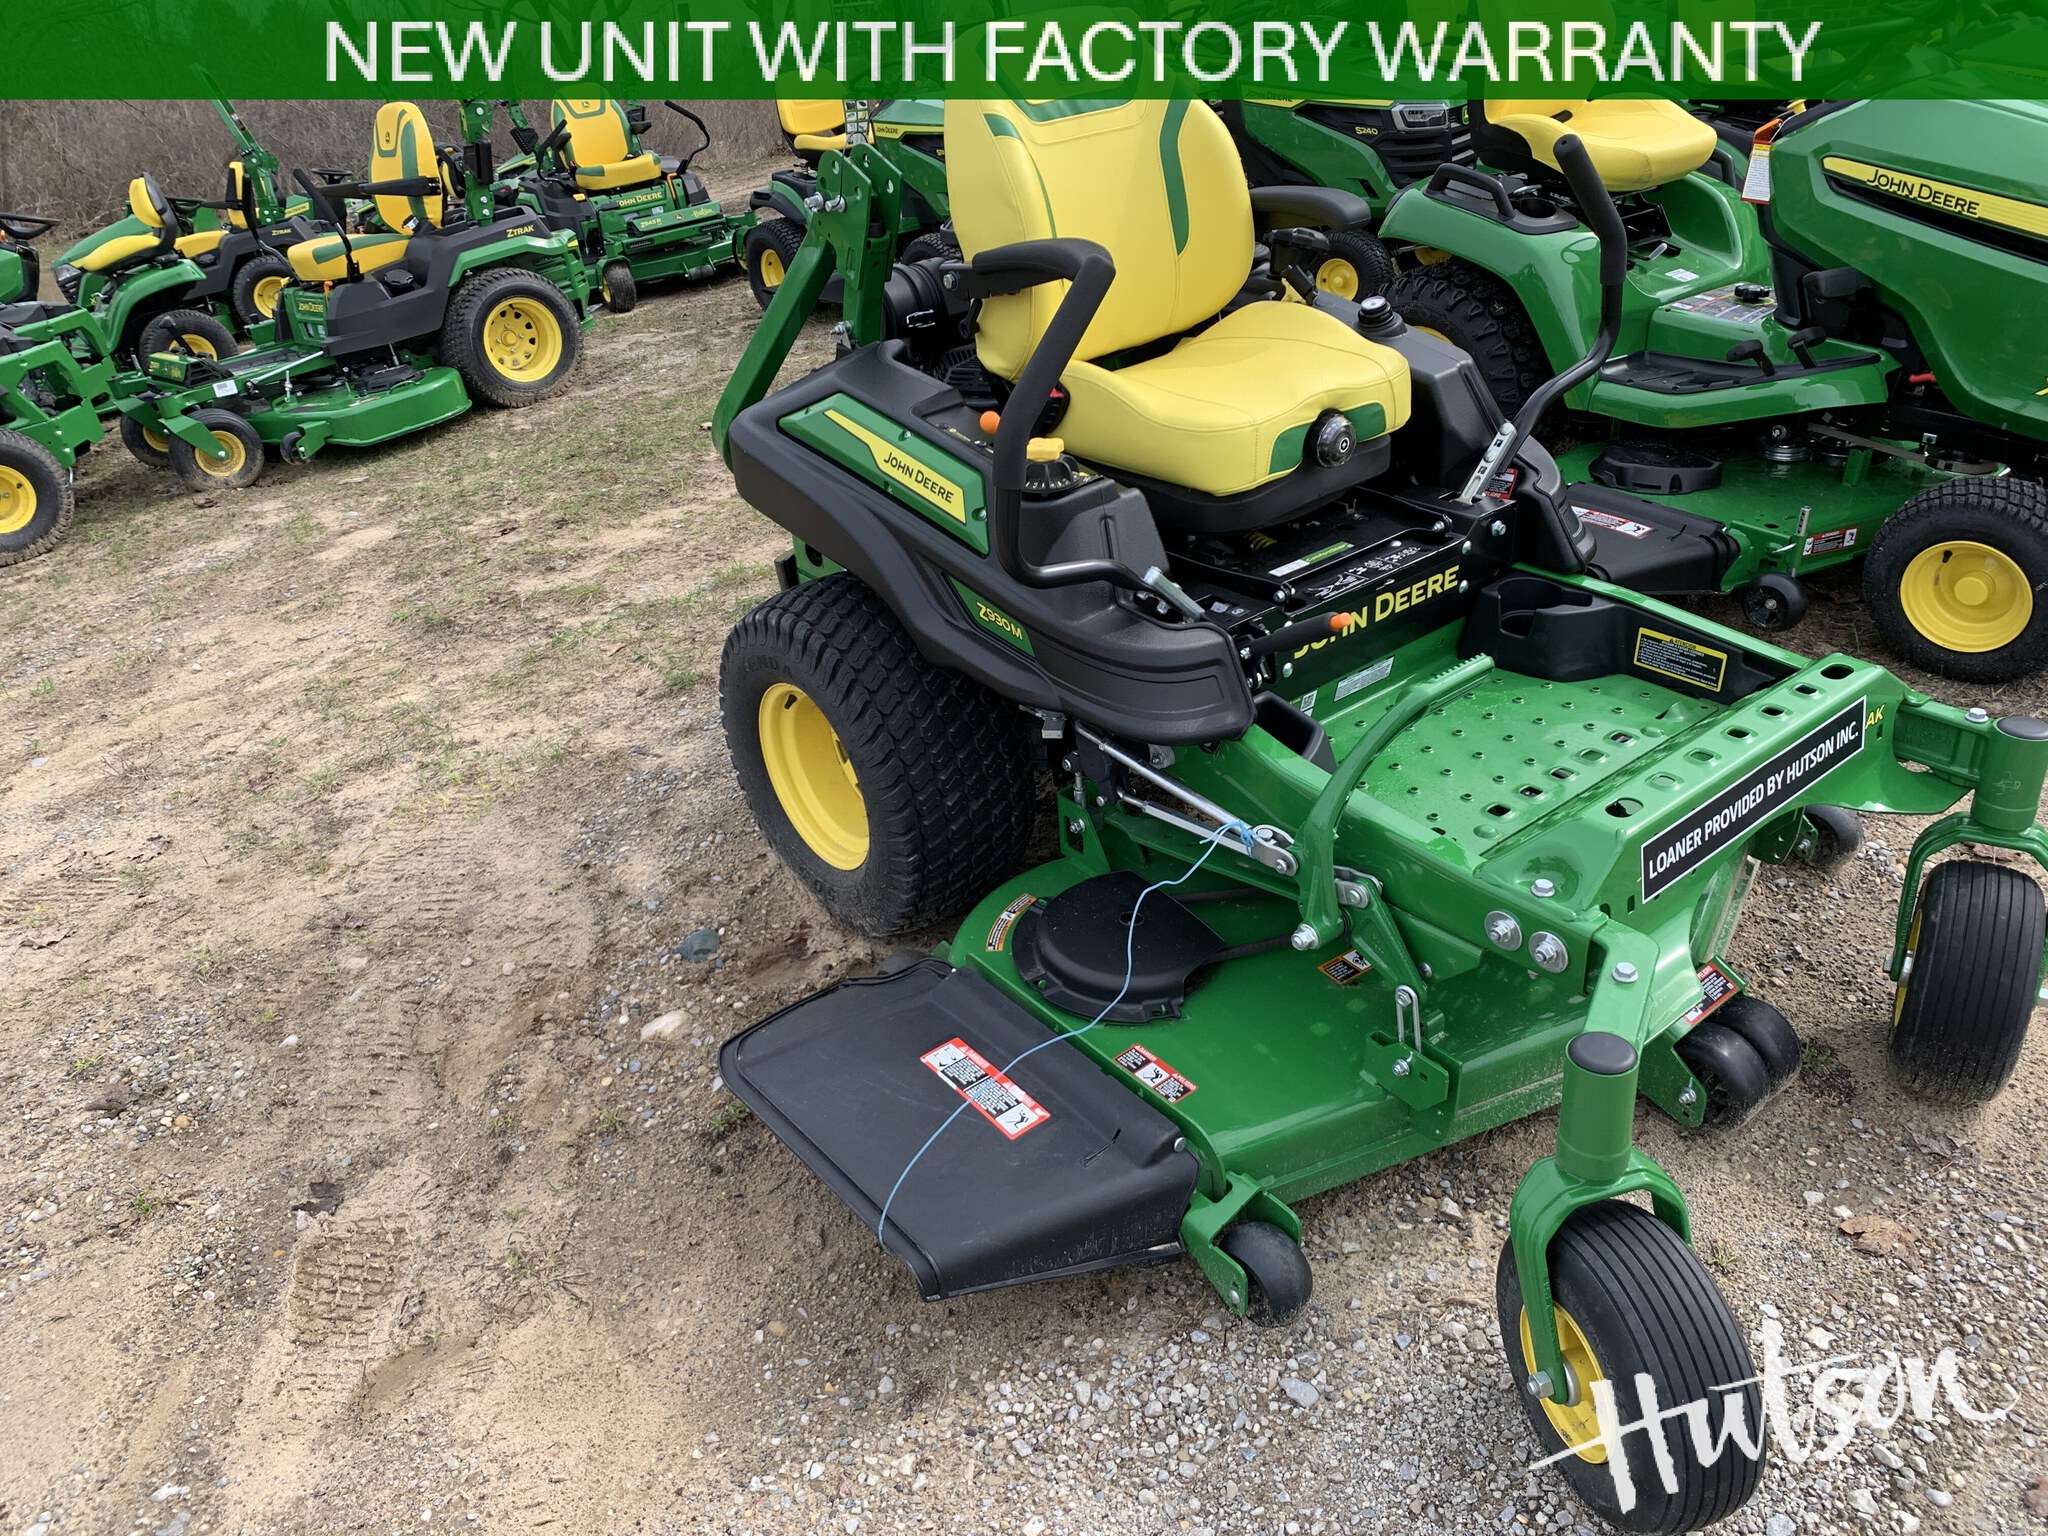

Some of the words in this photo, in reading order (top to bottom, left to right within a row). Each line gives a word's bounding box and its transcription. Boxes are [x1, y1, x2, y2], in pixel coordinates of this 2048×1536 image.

[1354, 126, 1379, 135] S240
[636, 191, 663, 203] DEERE
[1866, 168, 1915, 196] JOHN
[1917, 182, 1981, 216] DEERE
[506, 224, 535, 238] ZTRAK
[883, 452, 914, 479] JOHN
[914, 469, 954, 504] DEERE
[1375, 565, 1460, 622] DEERE
[976, 601, 1023, 640] Z930M
[1649, 827, 1702, 879] LOANER
[1704, 783, 1764, 841] PROVIDED
[1767, 769, 1785, 796] BY
[1786, 736, 1834, 784] HUTSON
[1836, 721, 1859, 750] INC.
